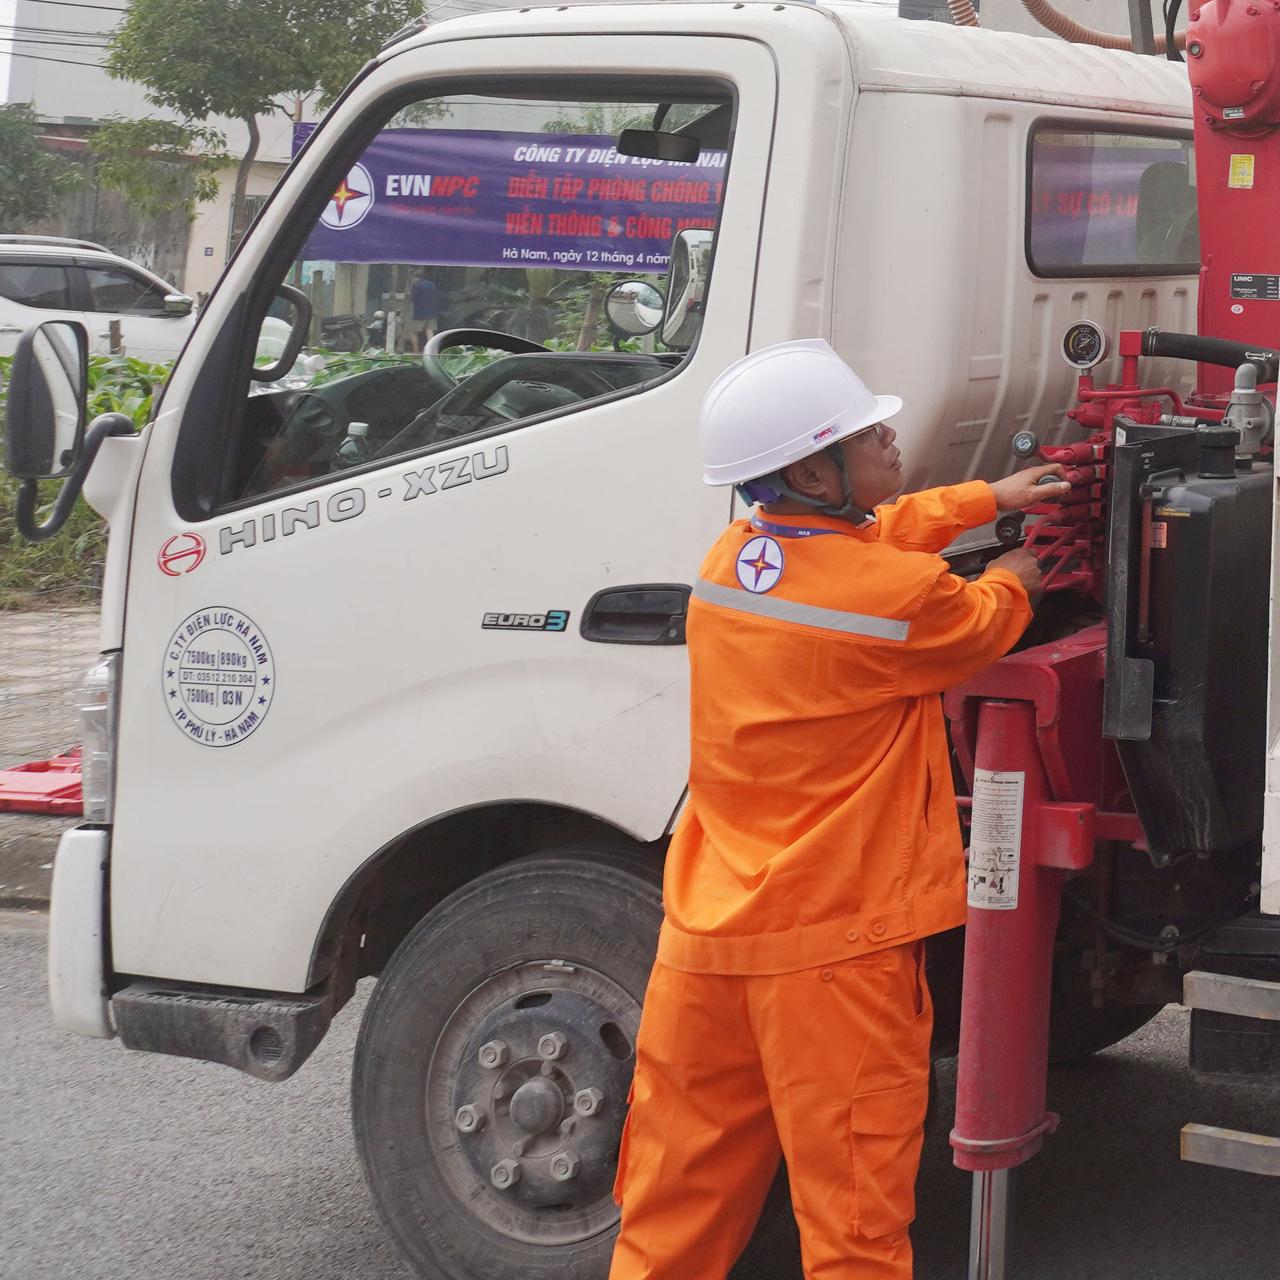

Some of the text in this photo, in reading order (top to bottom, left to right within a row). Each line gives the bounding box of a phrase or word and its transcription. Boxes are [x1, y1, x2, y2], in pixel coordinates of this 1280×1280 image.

[514, 144, 561, 162] CÔNG
[565, 148, 586, 163] TY
[695, 152, 727, 168] NA
[552, 173, 584, 203] TẬP
[589, 174, 647, 202] PHÒNG
[548, 209, 601, 237] THÔNG
[502, 248, 518, 259] Hà
[520, 248, 550, 262] Nam,
[553, 249, 582, 263] ngày
[586, 251, 599, 262] 12
[601, 251, 633, 265] tháng
[636, 253, 643, 263] 4
[249, 634, 268, 665] NAM
[175, 707, 188, 721] TP
[238, 711, 260, 735] NAM
